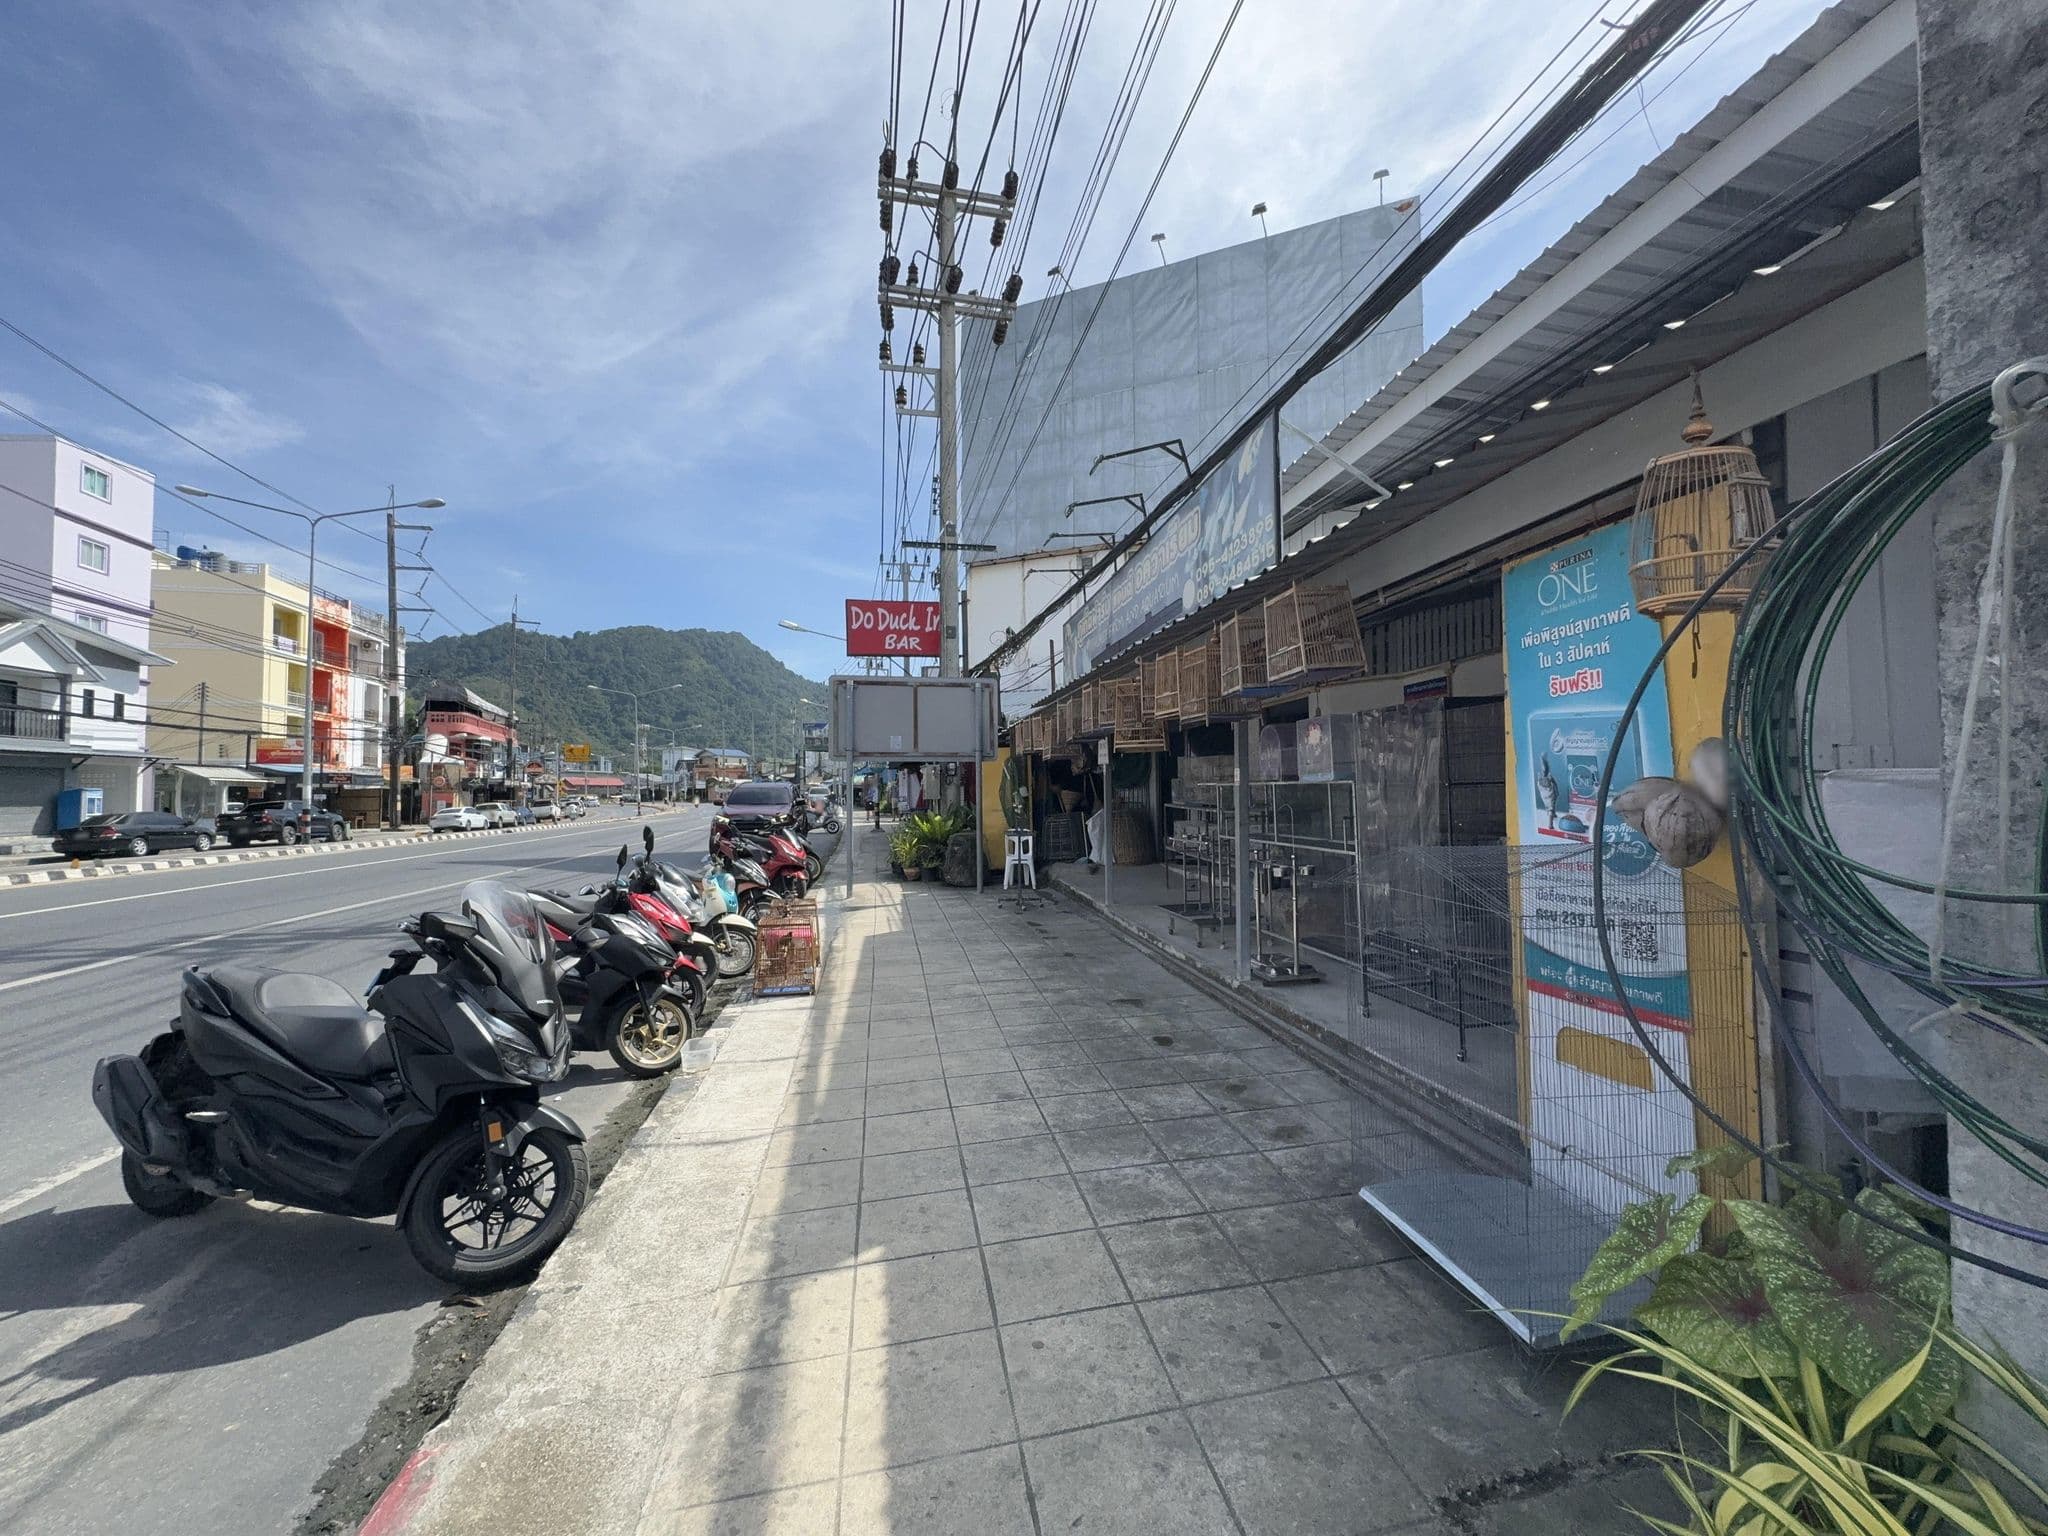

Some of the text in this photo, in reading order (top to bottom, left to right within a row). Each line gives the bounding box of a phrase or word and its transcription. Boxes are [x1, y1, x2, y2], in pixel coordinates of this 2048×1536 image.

[1558, 549, 1593, 569] PURINA
[1538, 562, 1598, 606] ONE
[851, 606, 873, 629] Do
[878, 604, 920, 631] Duck
[1521, 602, 1631, 648] เพื่อพิสูจน์สุขภาพดี
[885, 634, 922, 650] BAR
[1538, 636, 1610, 669] ใน 3 สัปดาห์
